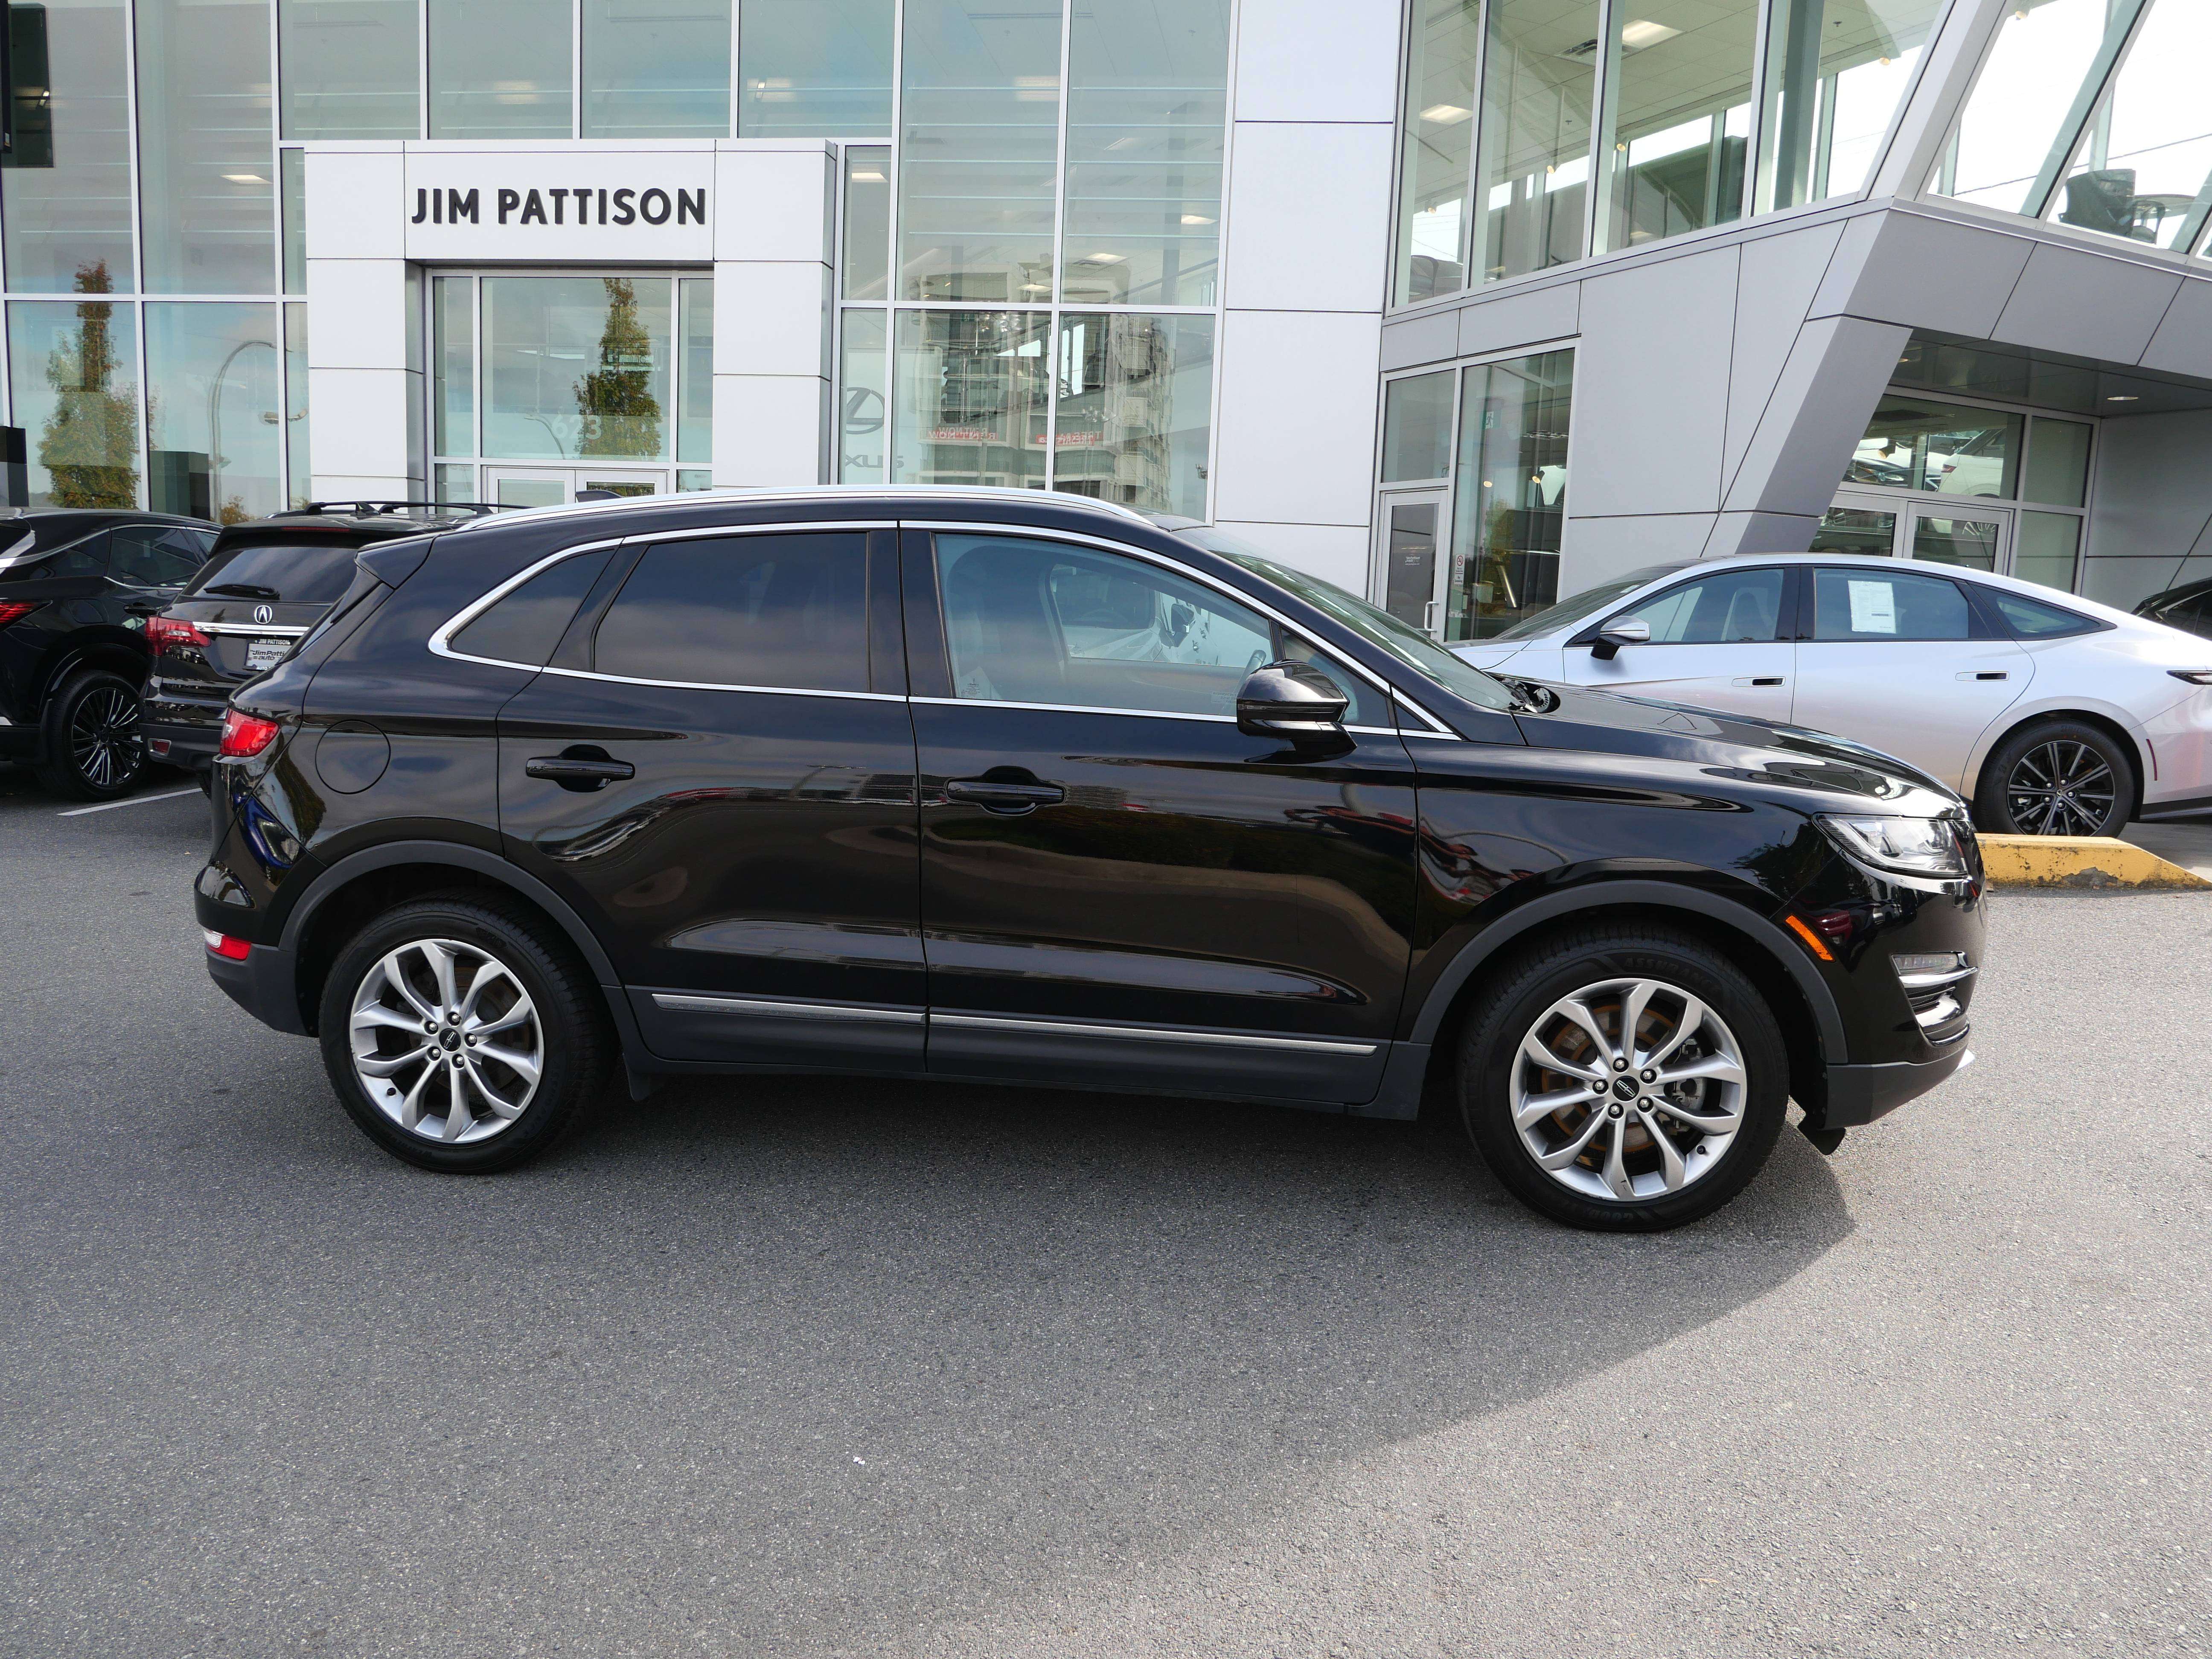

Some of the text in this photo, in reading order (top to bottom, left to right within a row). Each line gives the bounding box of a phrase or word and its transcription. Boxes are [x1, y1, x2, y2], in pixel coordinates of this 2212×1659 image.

[411, 188, 705, 225] JIM PATTISON
[552, 413, 602, 440] 623
[845, 454, 904, 469] XUS
